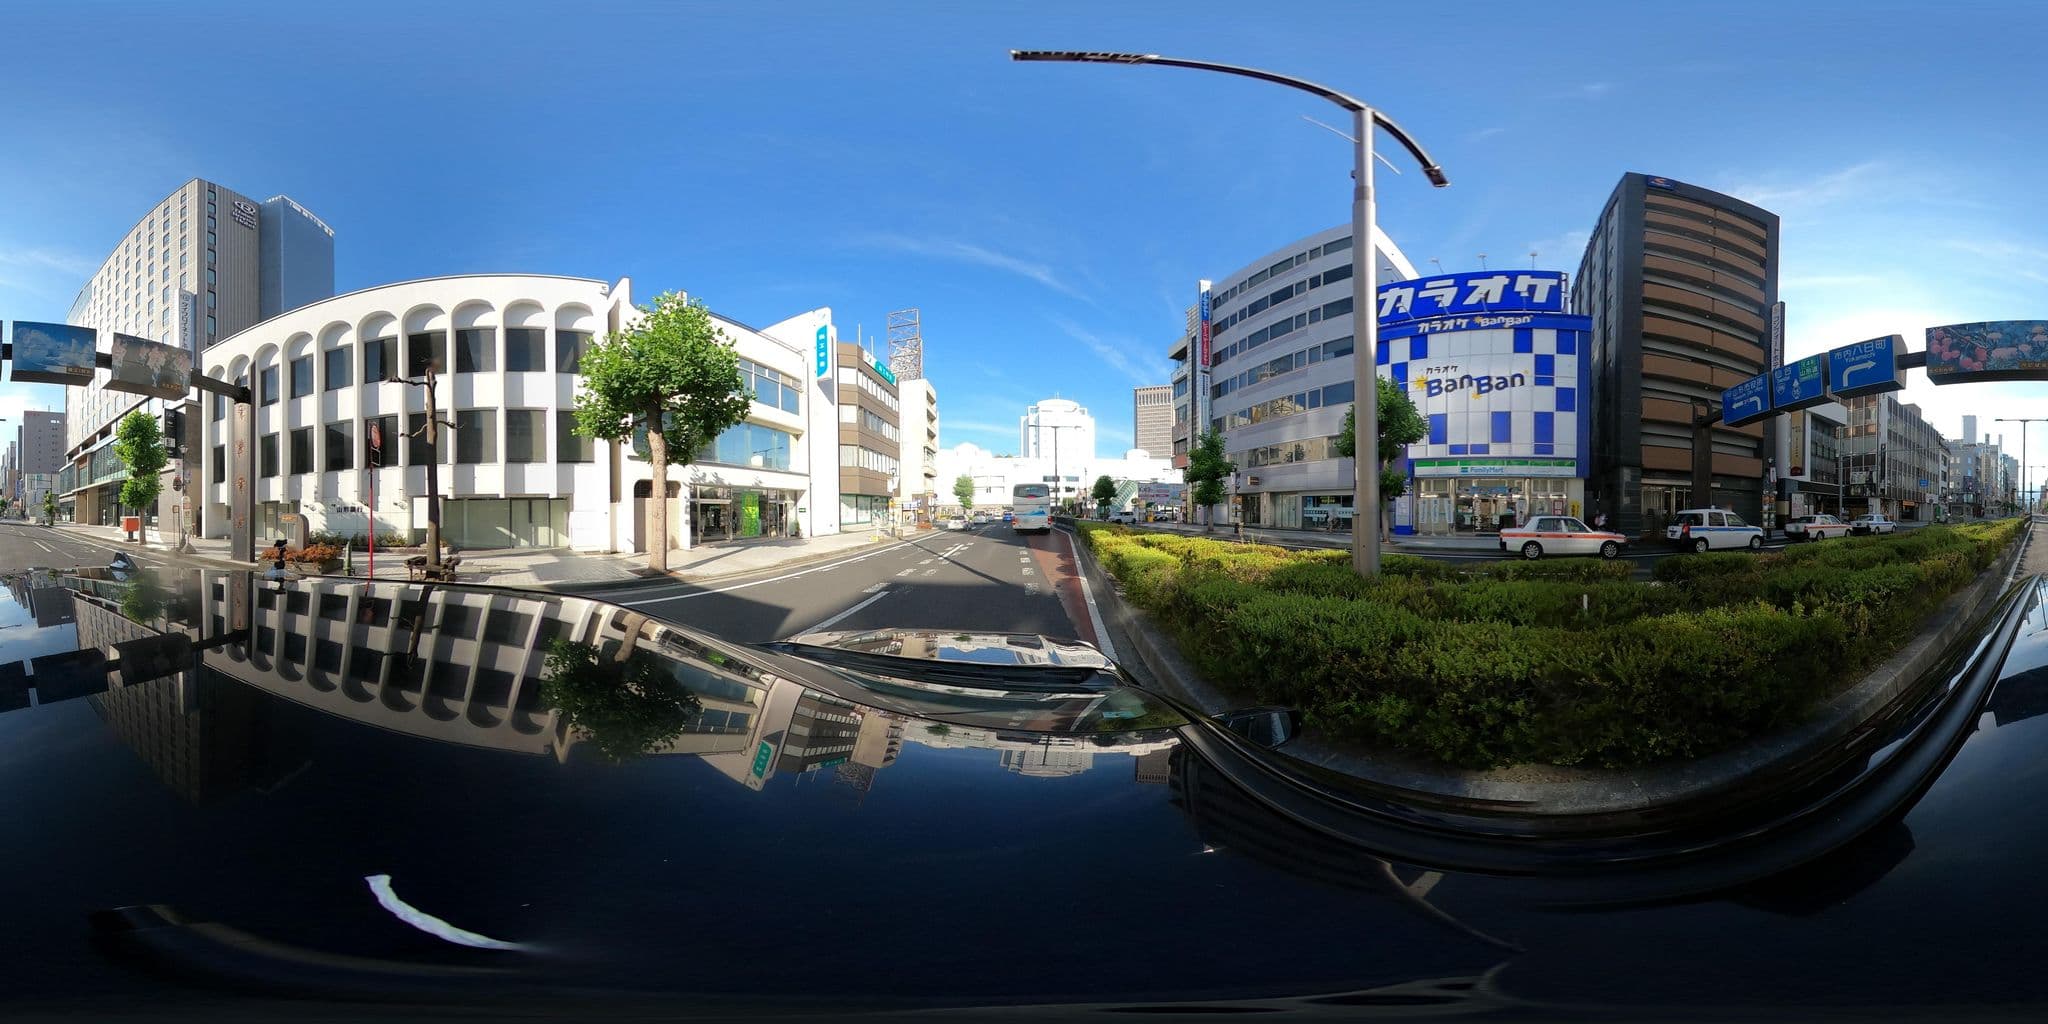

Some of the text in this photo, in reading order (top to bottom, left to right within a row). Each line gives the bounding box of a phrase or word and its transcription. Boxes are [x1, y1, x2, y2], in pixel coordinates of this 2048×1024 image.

[1378, 274, 1558, 318] カラオケ
[1418, 316, 1530, 333] カラオケ BanBan
[1426, 365, 1458, 374] カラオケ
[1424, 373, 1525, 397] BanBan
